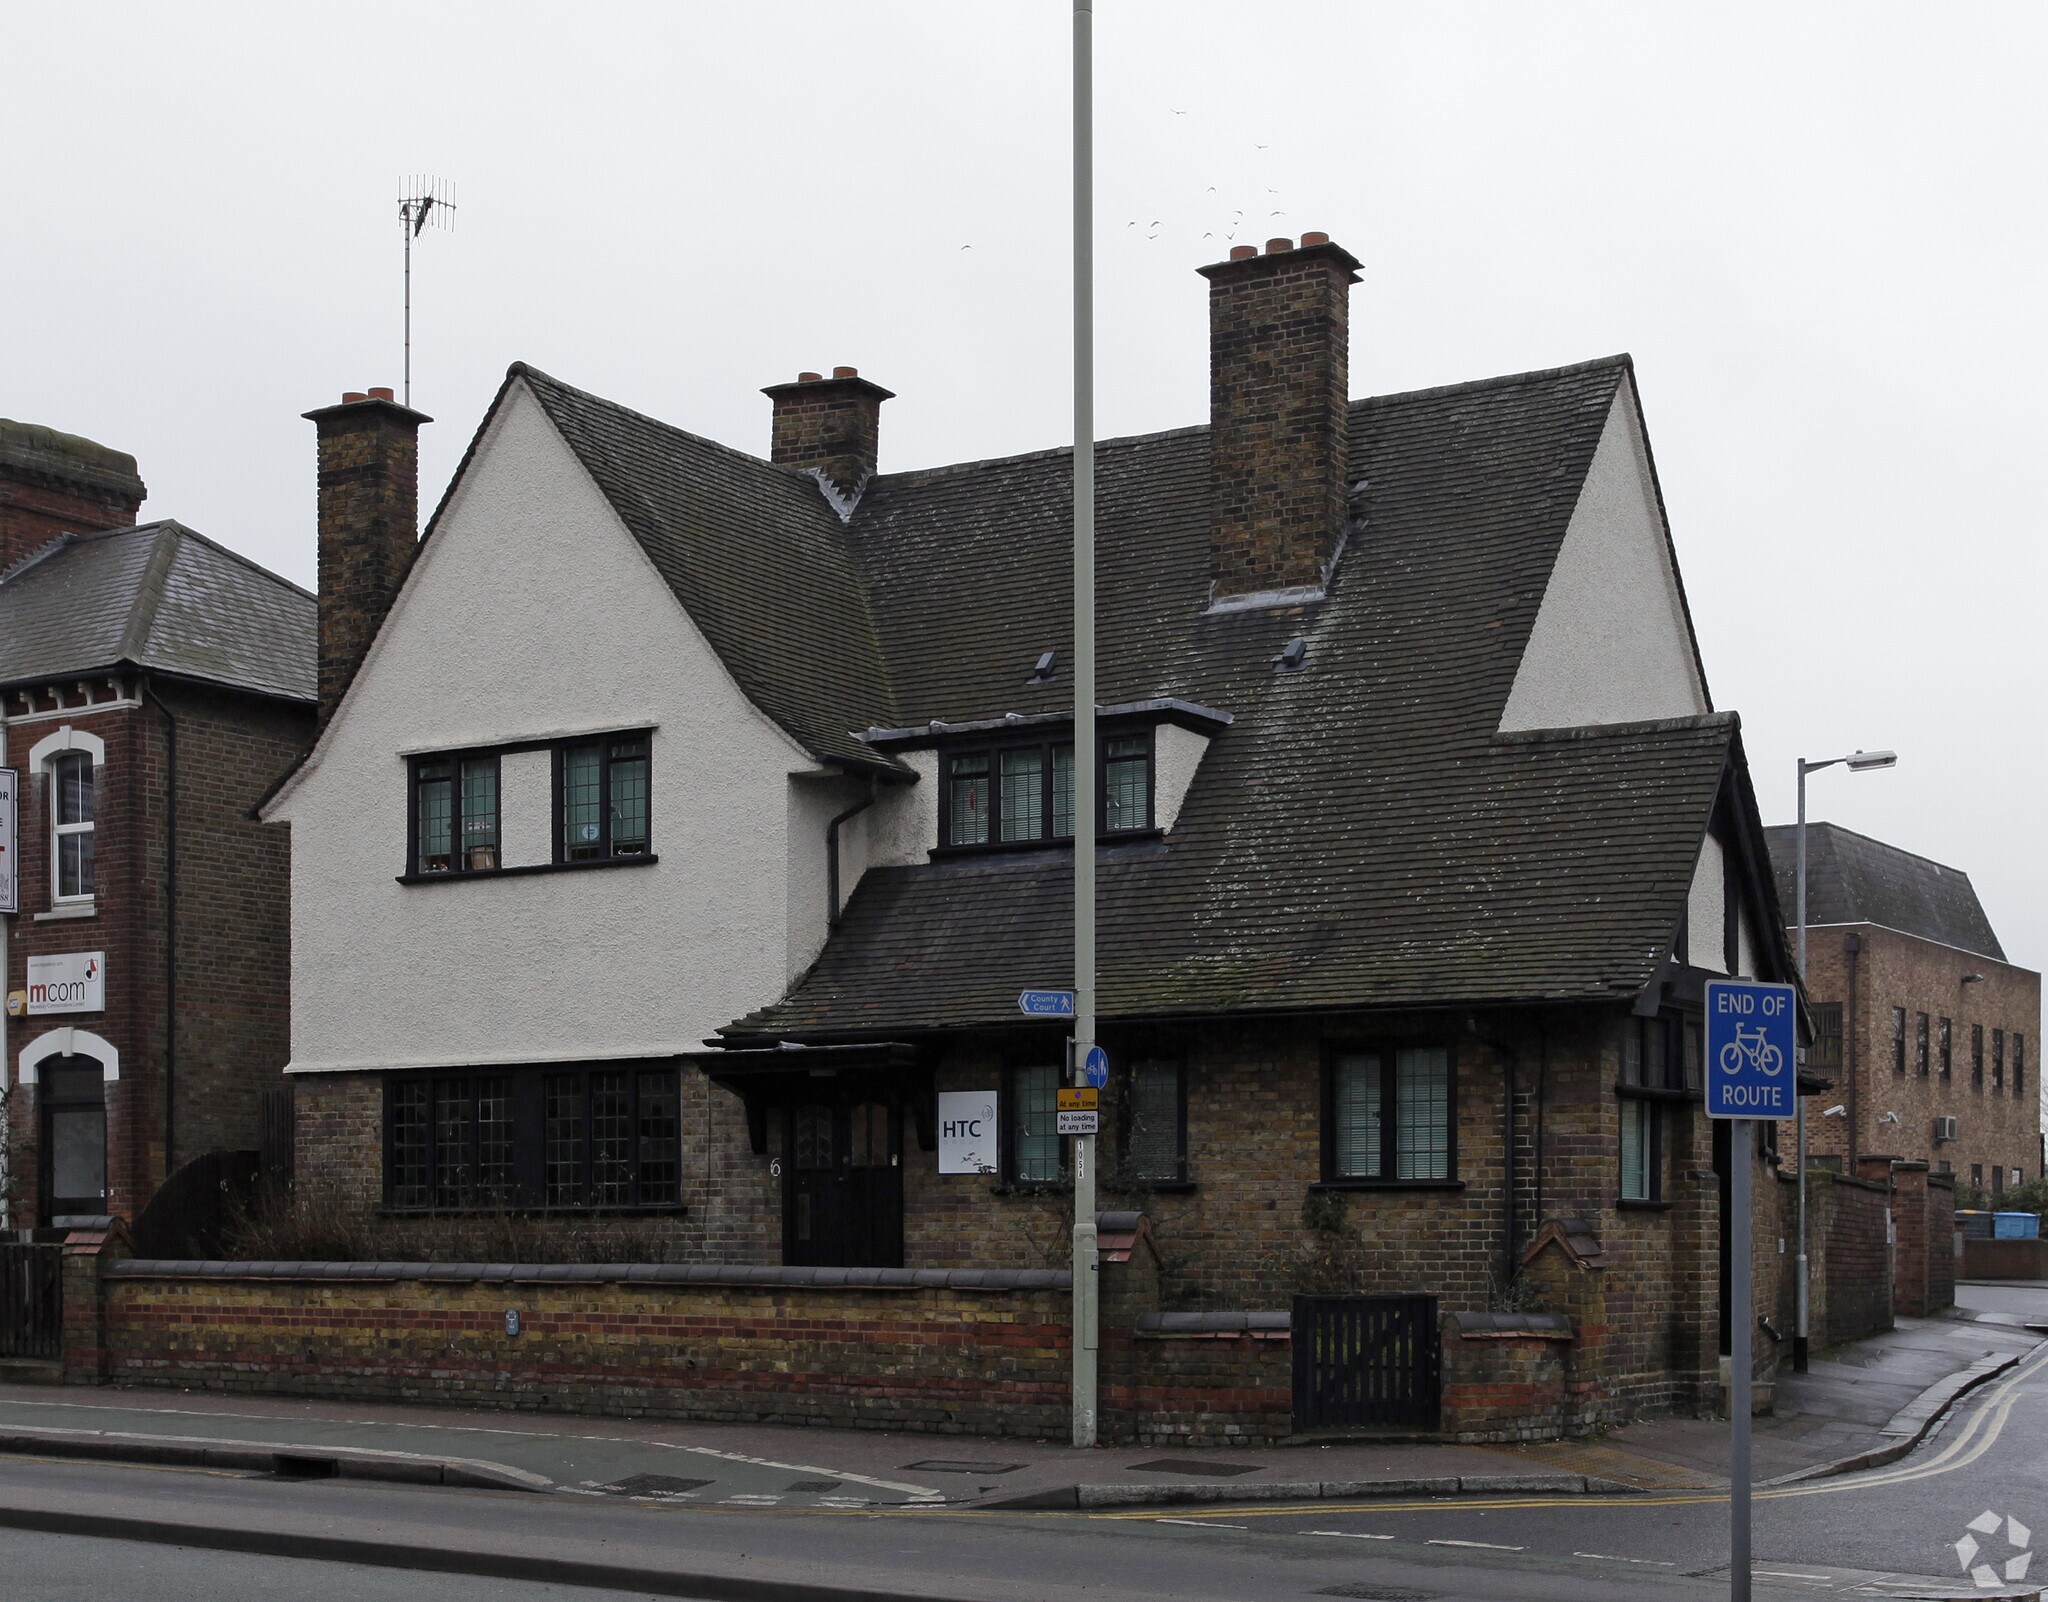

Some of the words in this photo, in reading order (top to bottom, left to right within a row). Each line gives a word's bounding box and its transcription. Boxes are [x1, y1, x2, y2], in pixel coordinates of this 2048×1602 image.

[30, 981, 85, 1003] mcom
[1030, 994, 1058, 1004] County
[1033, 1003, 1055, 1011] Court
[1718, 993, 1755, 1015] END
[1762, 995, 1786, 1016] OF
[1722, 1085, 1782, 1107] ROUTE
[1071, 1114, 1095, 1122] loading
[943, 1120, 982, 1138] HTC
[770, 1157, 781, 1176] 6
